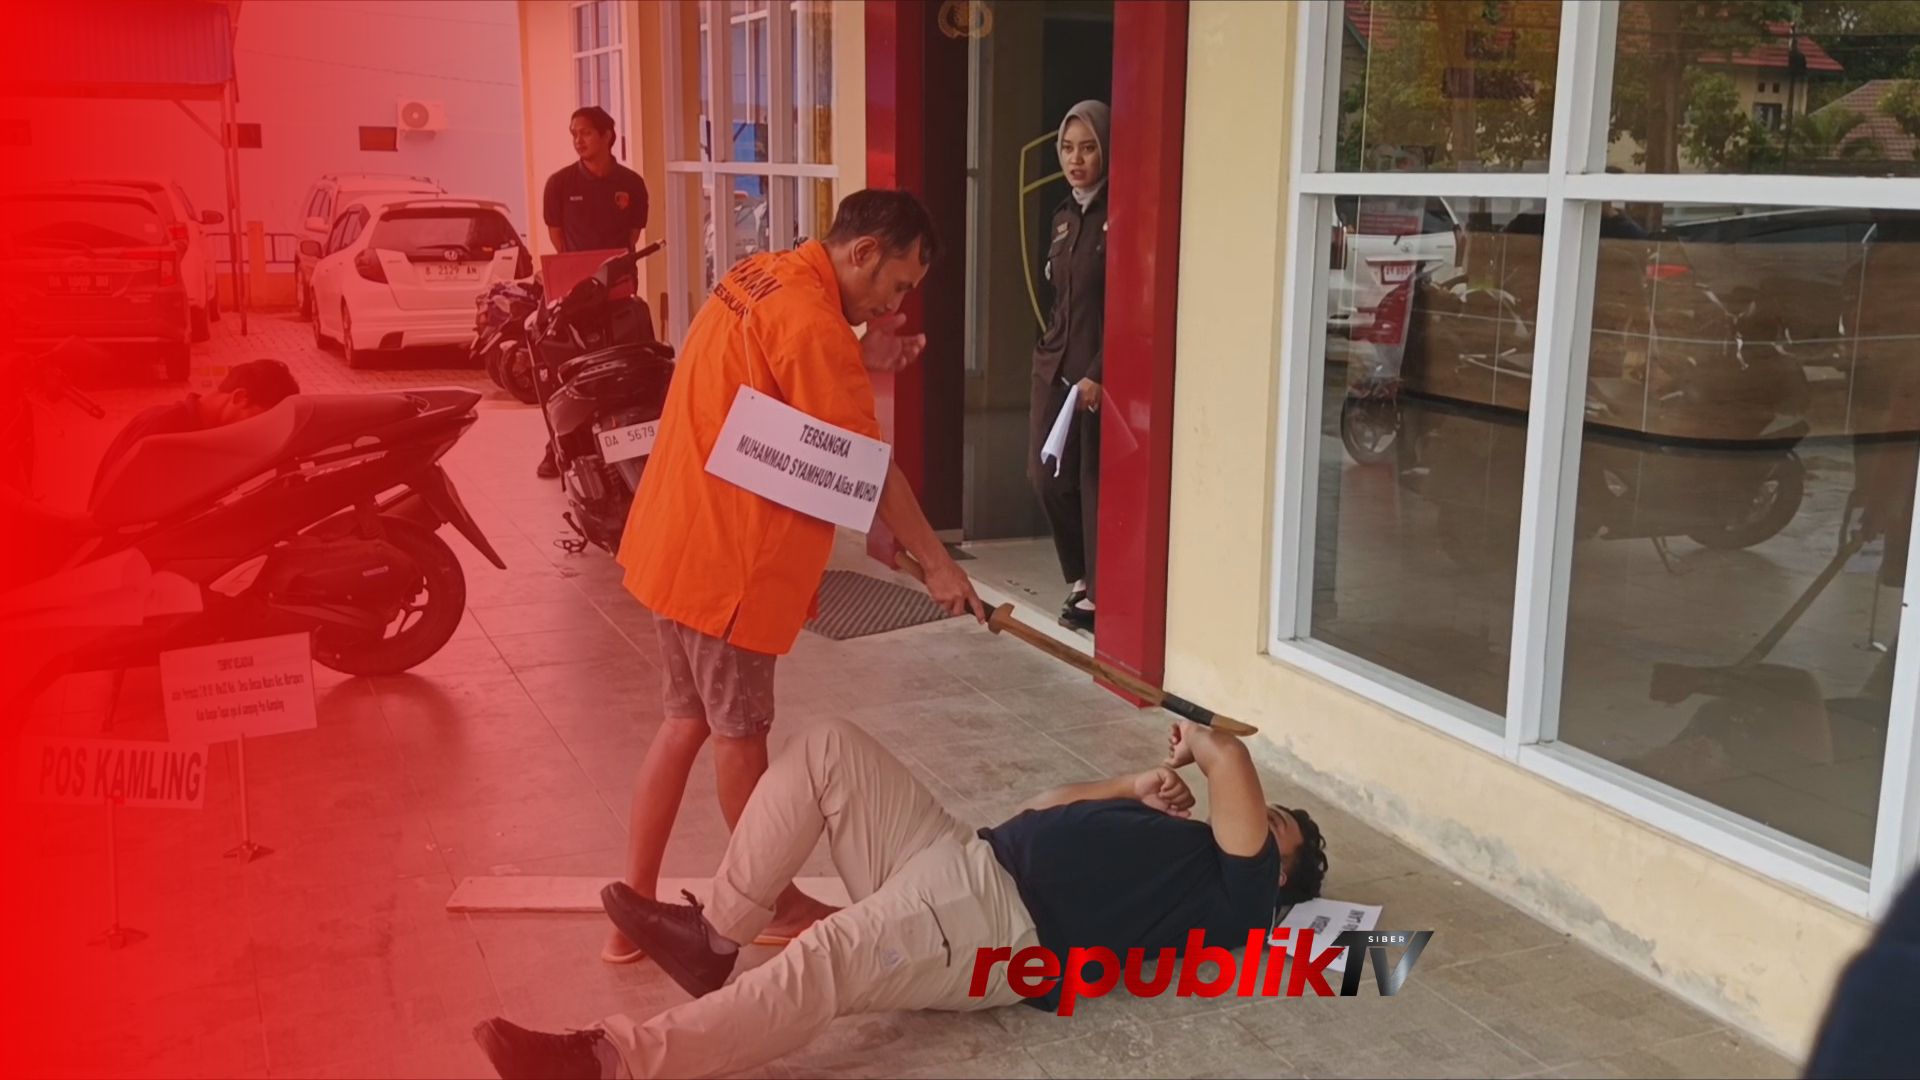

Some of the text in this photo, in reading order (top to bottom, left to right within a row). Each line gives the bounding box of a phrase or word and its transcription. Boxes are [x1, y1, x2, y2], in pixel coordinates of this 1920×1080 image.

[603, 425, 655, 447] DA 5679
[799, 424, 852, 458] TERSANGKA
[736, 434, 879, 502] MUHAMMAD SYAMHUDI Alias MUHDI
[39, 744, 202, 802] POS KAMLING
